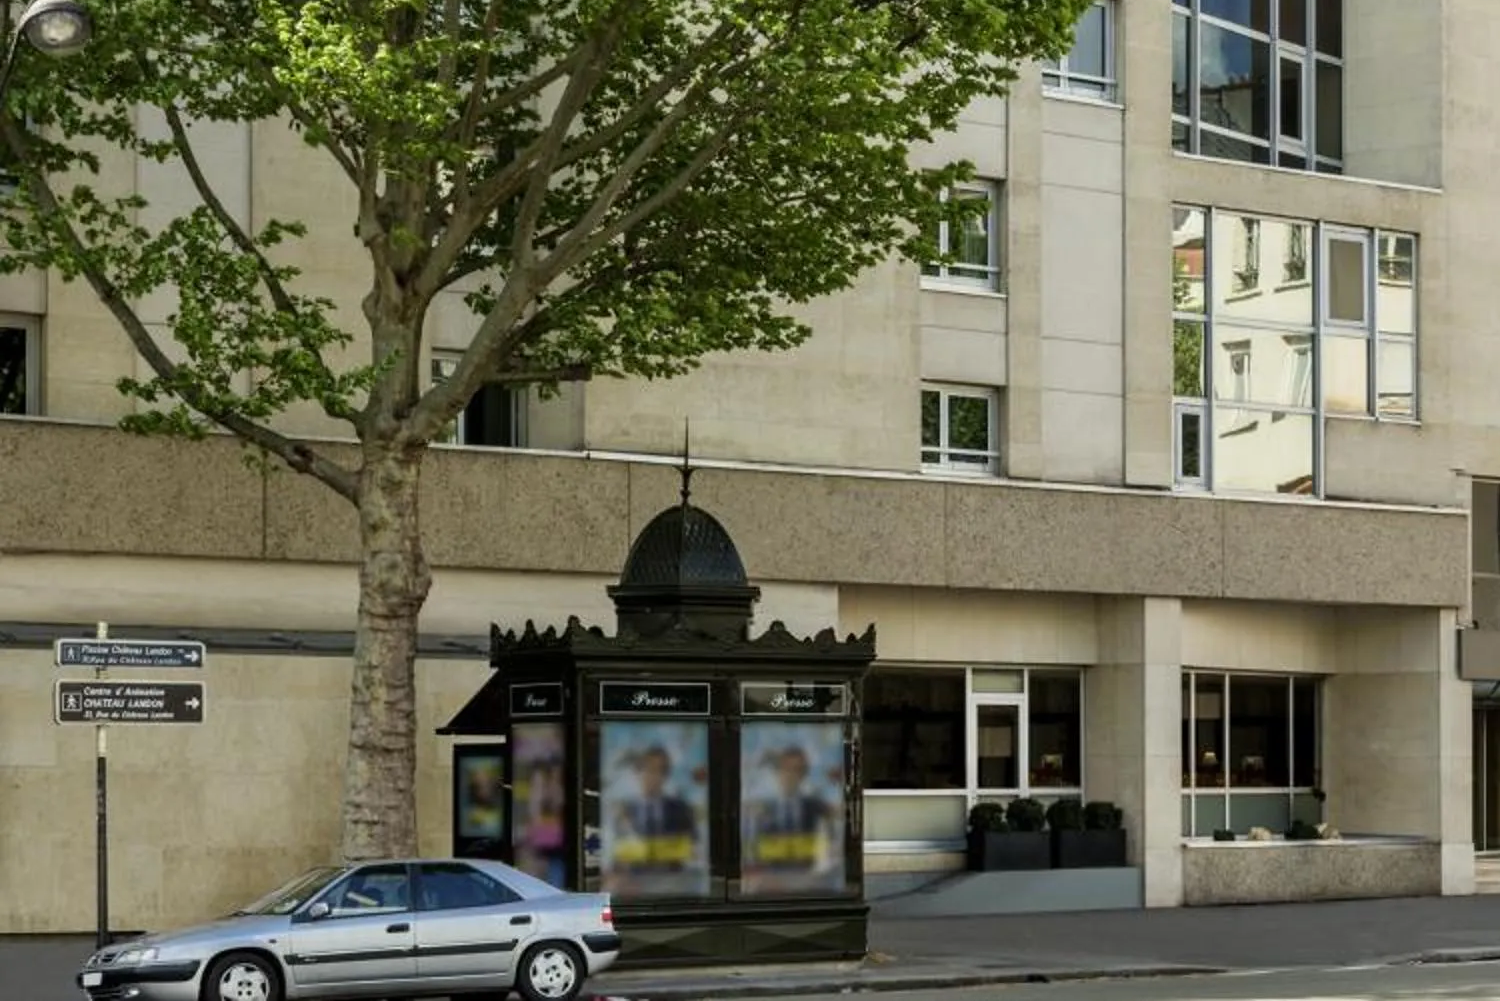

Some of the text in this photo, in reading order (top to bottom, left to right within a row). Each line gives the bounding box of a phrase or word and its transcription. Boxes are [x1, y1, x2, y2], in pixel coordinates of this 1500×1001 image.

[84, 686, 112, 696] Centre
[127, 699, 165, 709] LANDON
[630, 689, 681, 707] Presse
[769, 692, 815, 709] Presse
